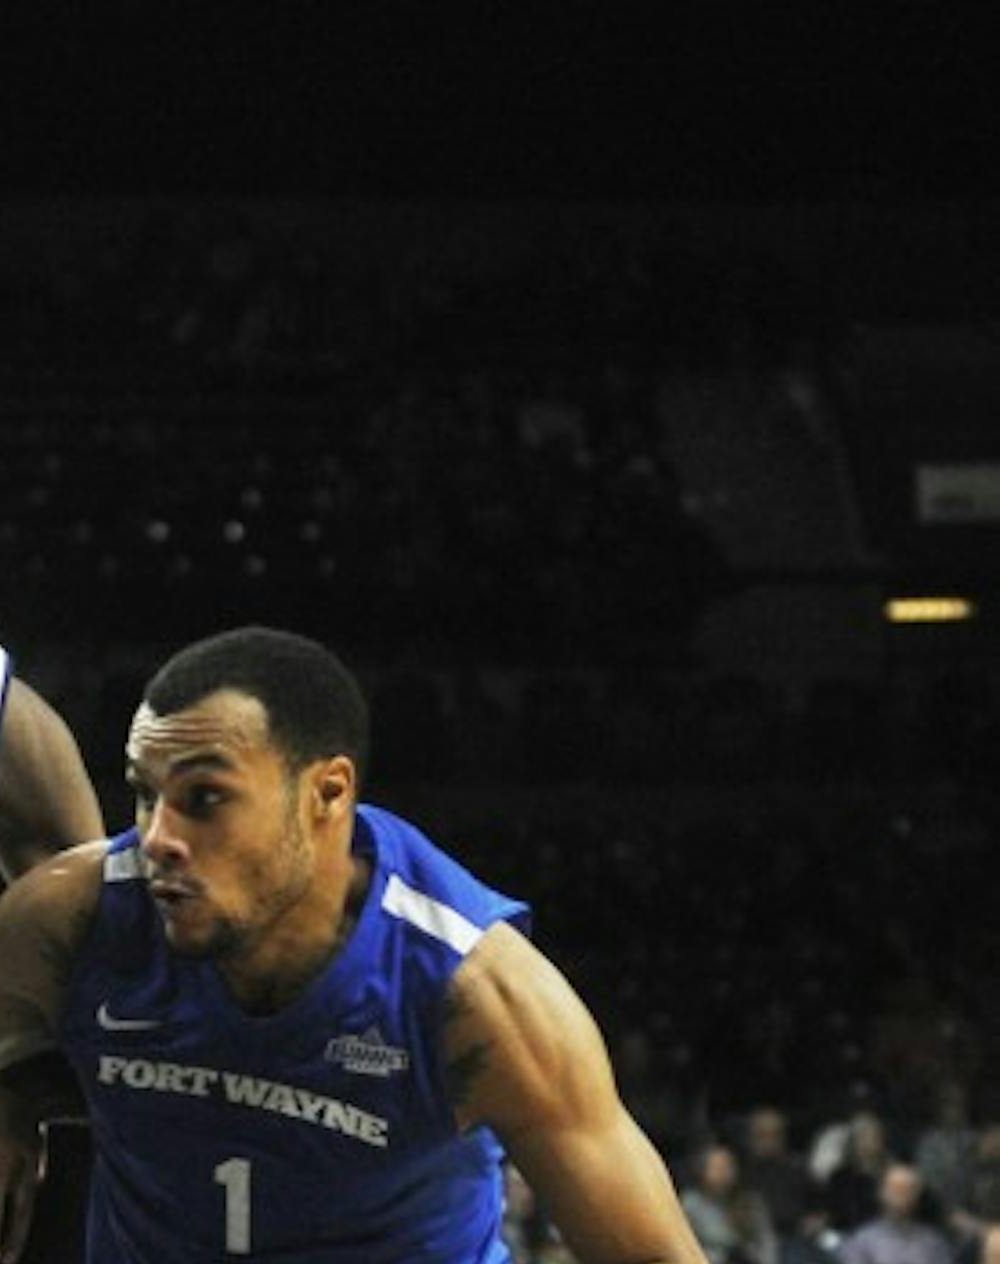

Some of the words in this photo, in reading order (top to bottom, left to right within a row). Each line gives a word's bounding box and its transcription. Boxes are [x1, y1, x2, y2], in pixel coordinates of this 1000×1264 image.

[98, 1054, 219, 1096] FORT
[222, 1071, 389, 1148] WAYNE
[213, 1156, 251, 1254] 1
